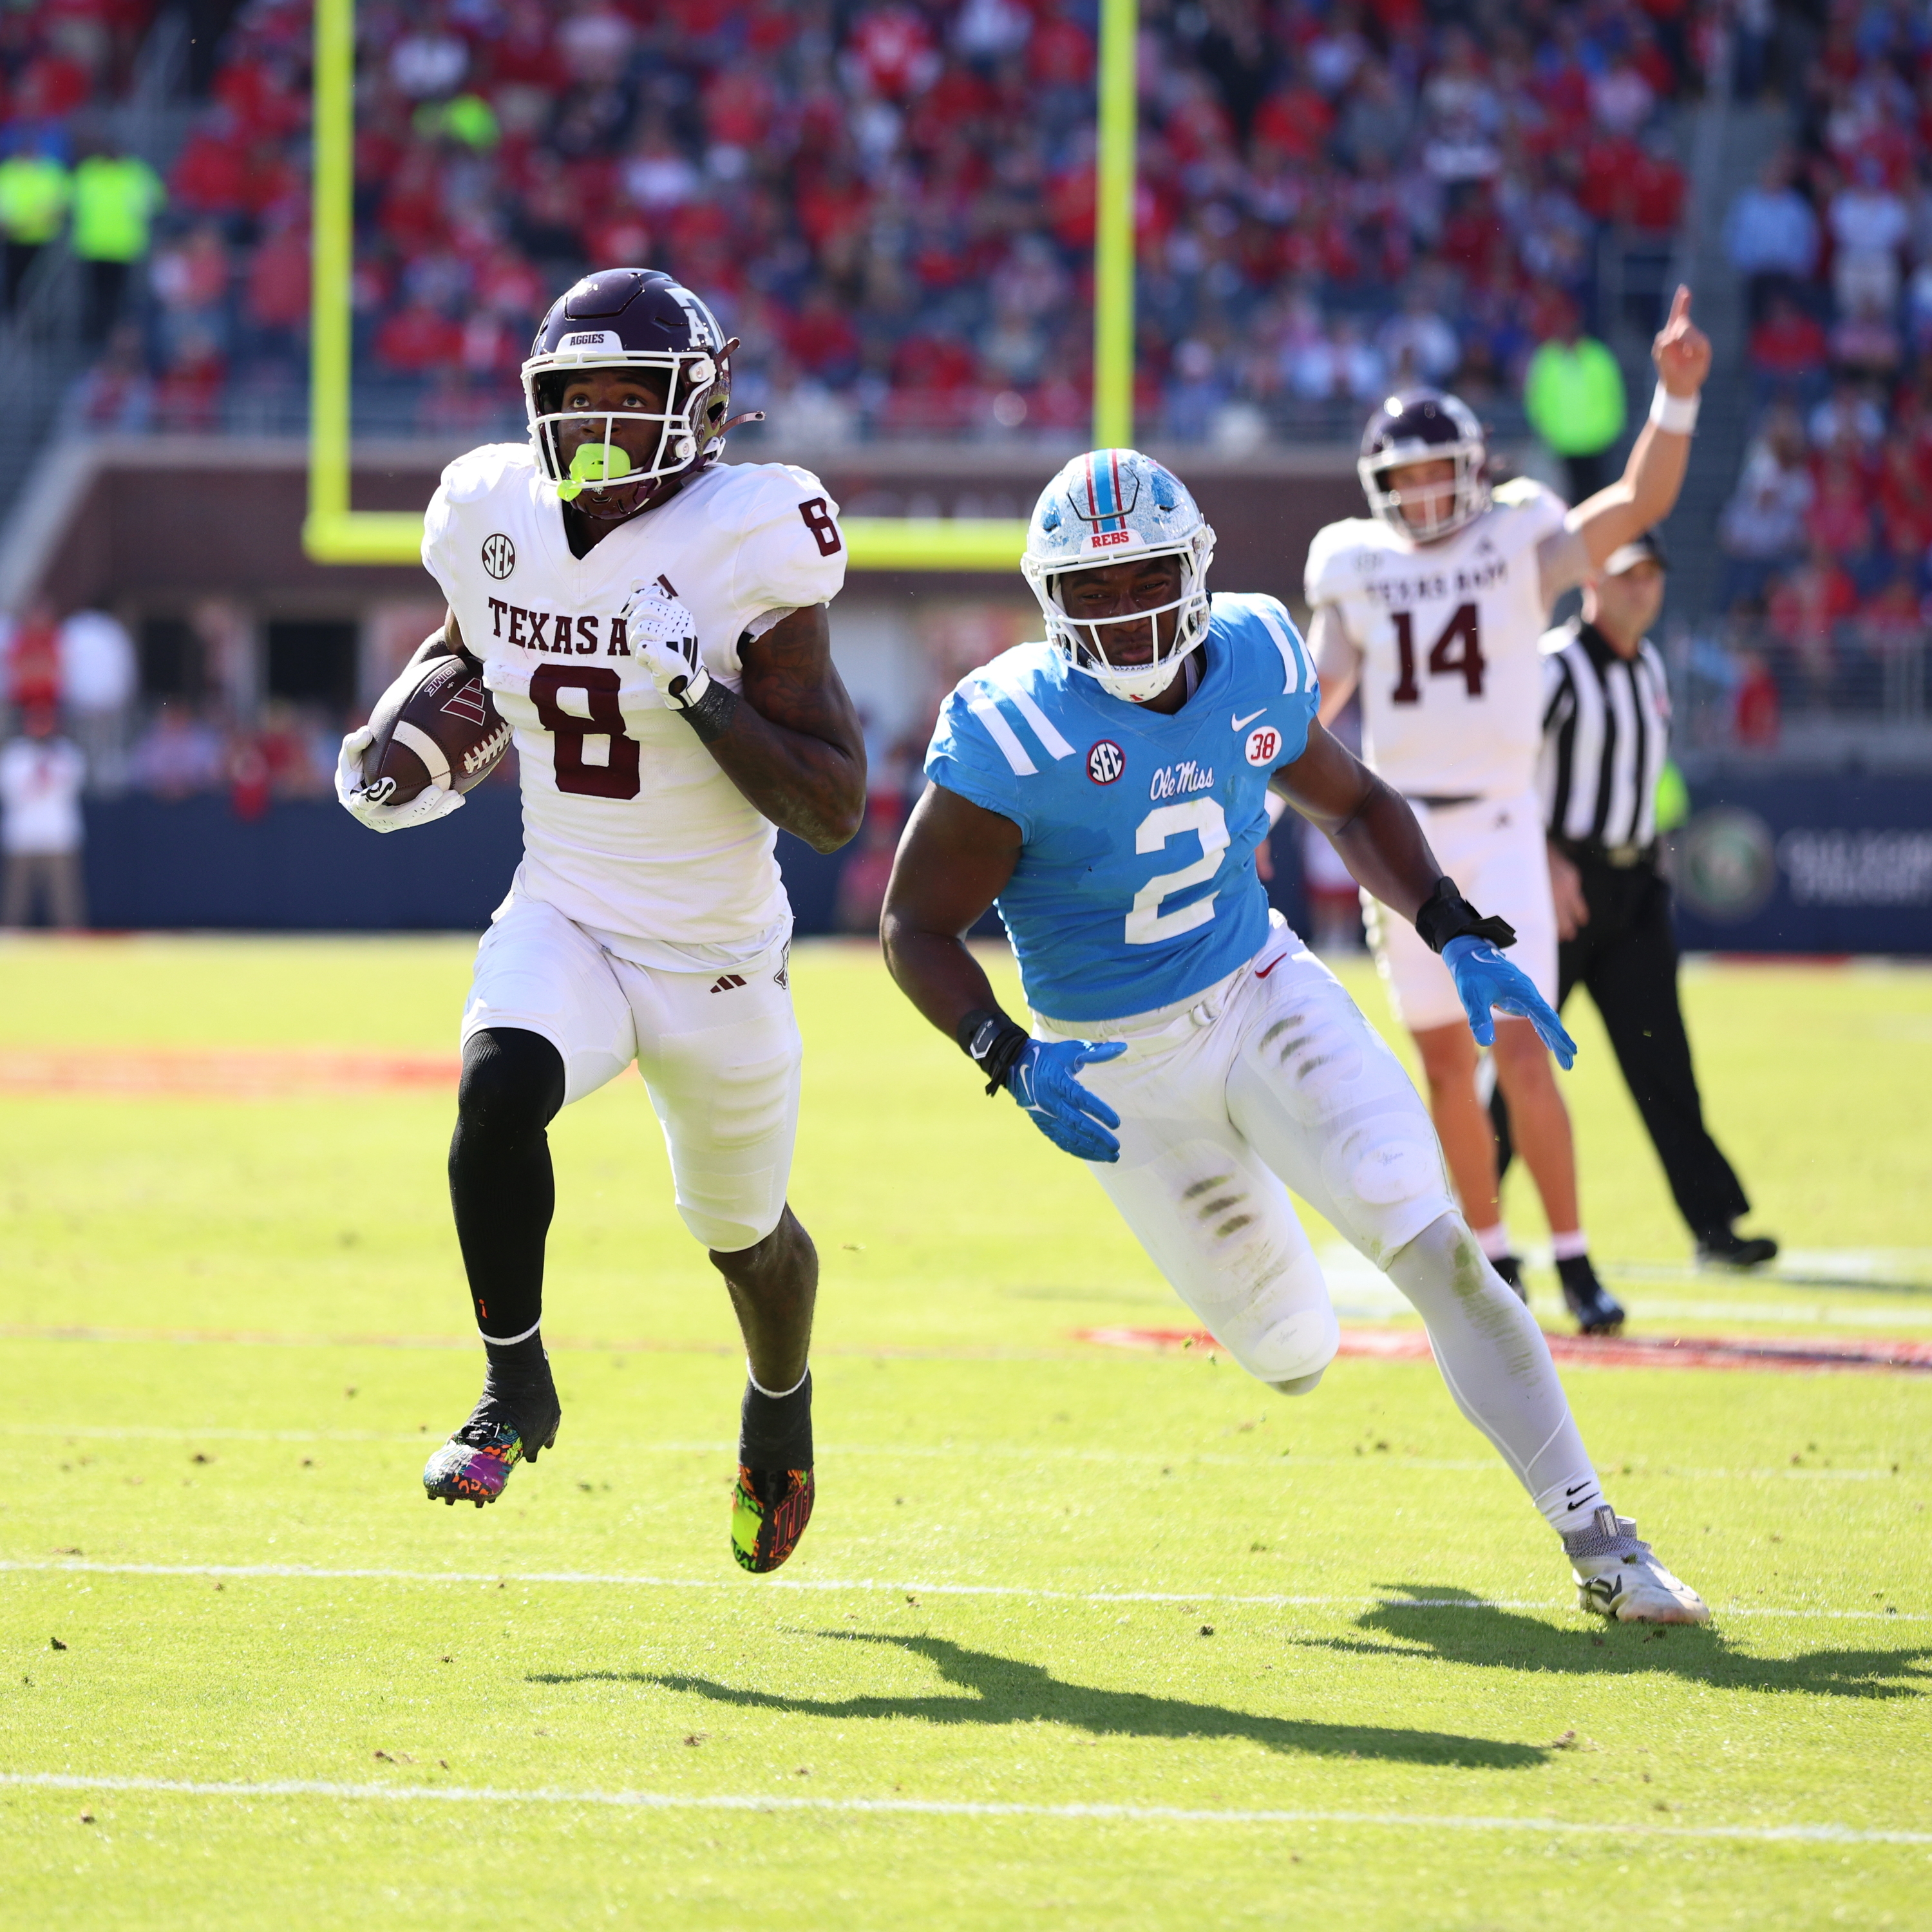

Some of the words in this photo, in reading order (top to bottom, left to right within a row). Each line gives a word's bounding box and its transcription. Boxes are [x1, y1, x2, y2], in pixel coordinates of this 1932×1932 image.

[569, 334, 605, 346] AGGIES
[798, 497, 842, 558] 8
[1091, 531, 1130, 548] REBS
[482, 535, 514, 578] SEC
[488, 596, 599, 655] TEXAS
[1390, 601, 1486, 705] 14
[424, 666, 457, 697] DIME
[529, 663, 641, 800] 8
[1251, 732, 1276, 761] 38
[1090, 742, 1123, 783] SEC
[1150, 766, 1177, 801] Ole
[1175, 760, 1215, 794] Miss
[1124, 796, 1231, 945] 2
